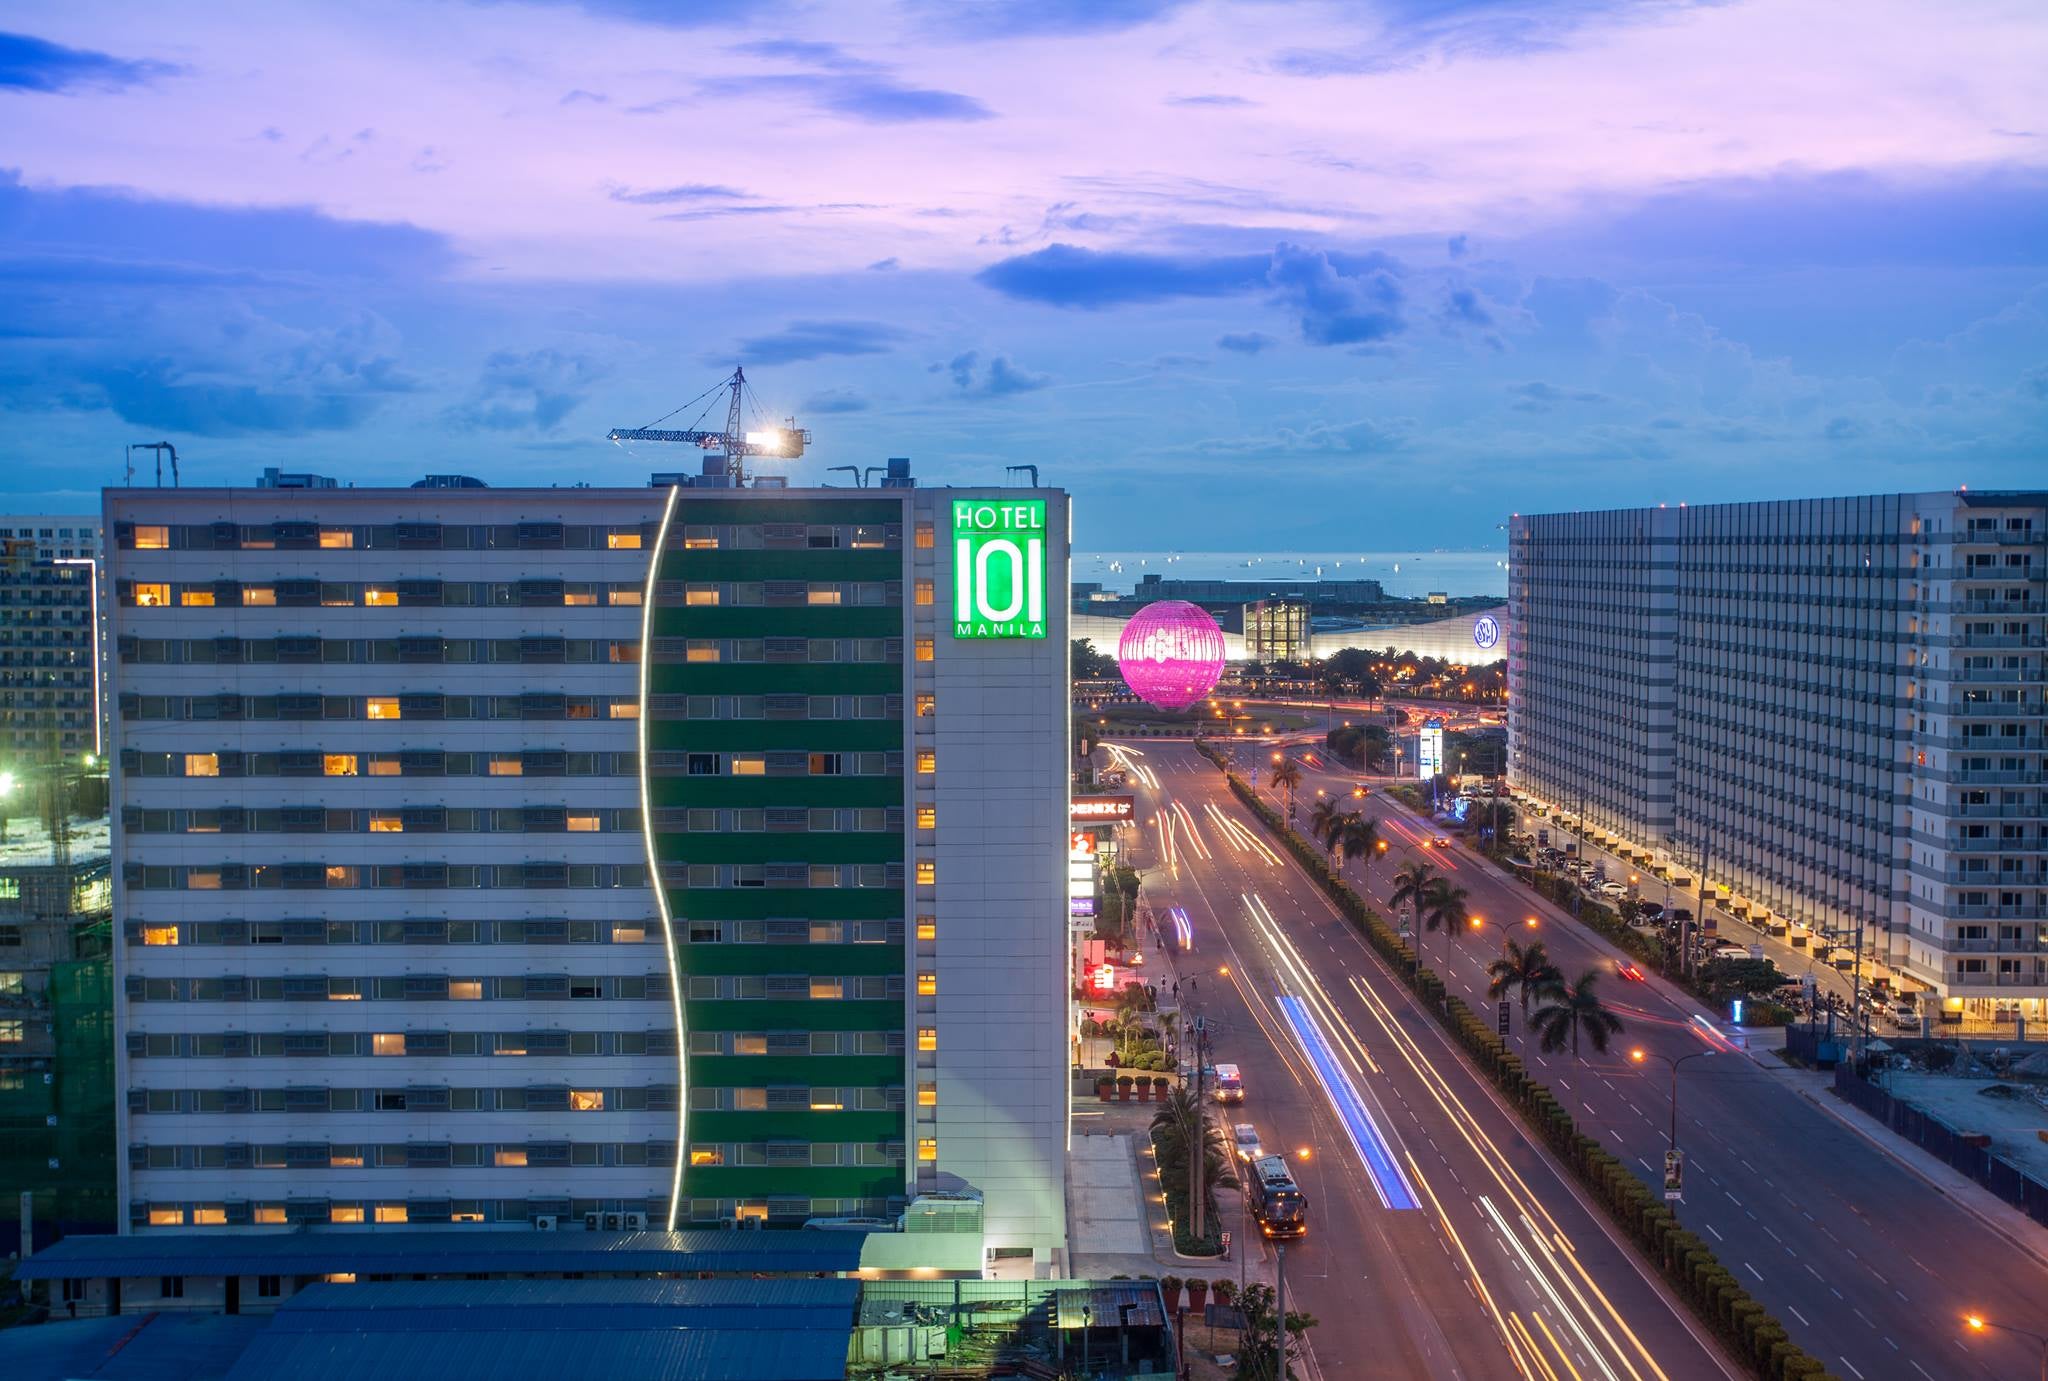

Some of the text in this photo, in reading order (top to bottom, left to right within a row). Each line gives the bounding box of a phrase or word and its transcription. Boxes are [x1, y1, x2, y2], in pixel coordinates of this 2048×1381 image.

[957, 507, 1041, 528] HOTEL
[957, 539, 1041, 622] 101
[957, 623, 1042, 636] MANILA
